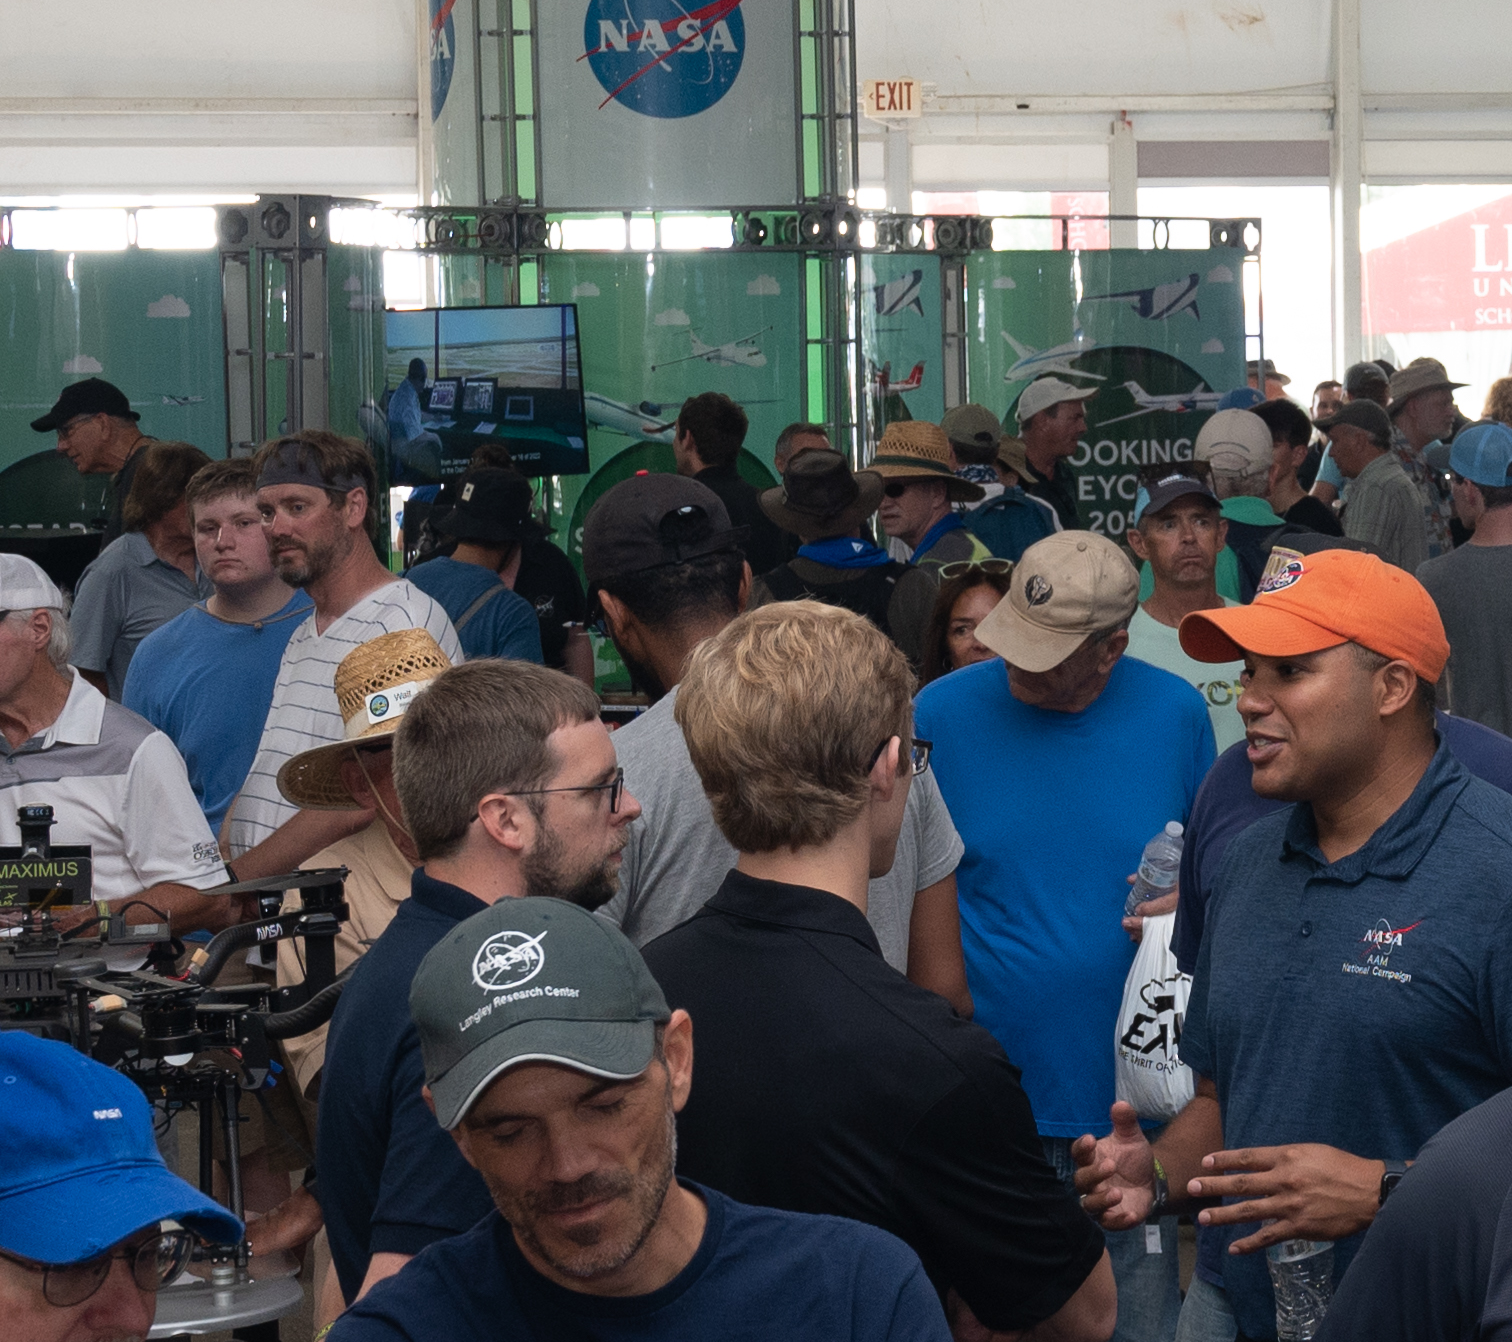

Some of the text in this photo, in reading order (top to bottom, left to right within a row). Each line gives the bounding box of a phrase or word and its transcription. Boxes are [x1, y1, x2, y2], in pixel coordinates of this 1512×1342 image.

[597, 18, 738, 53] NASA
[875, 82, 914, 111] EXIT
[1067, 438, 1193, 467] OOKING
[256, 922, 284, 941] NASA
[1364, 928, 1403, 946] NASA
[478, 946, 539, 977] NASA
[1367, 954, 1389, 967] AAM
[458, 985, 580, 1033] Langley Research Center
